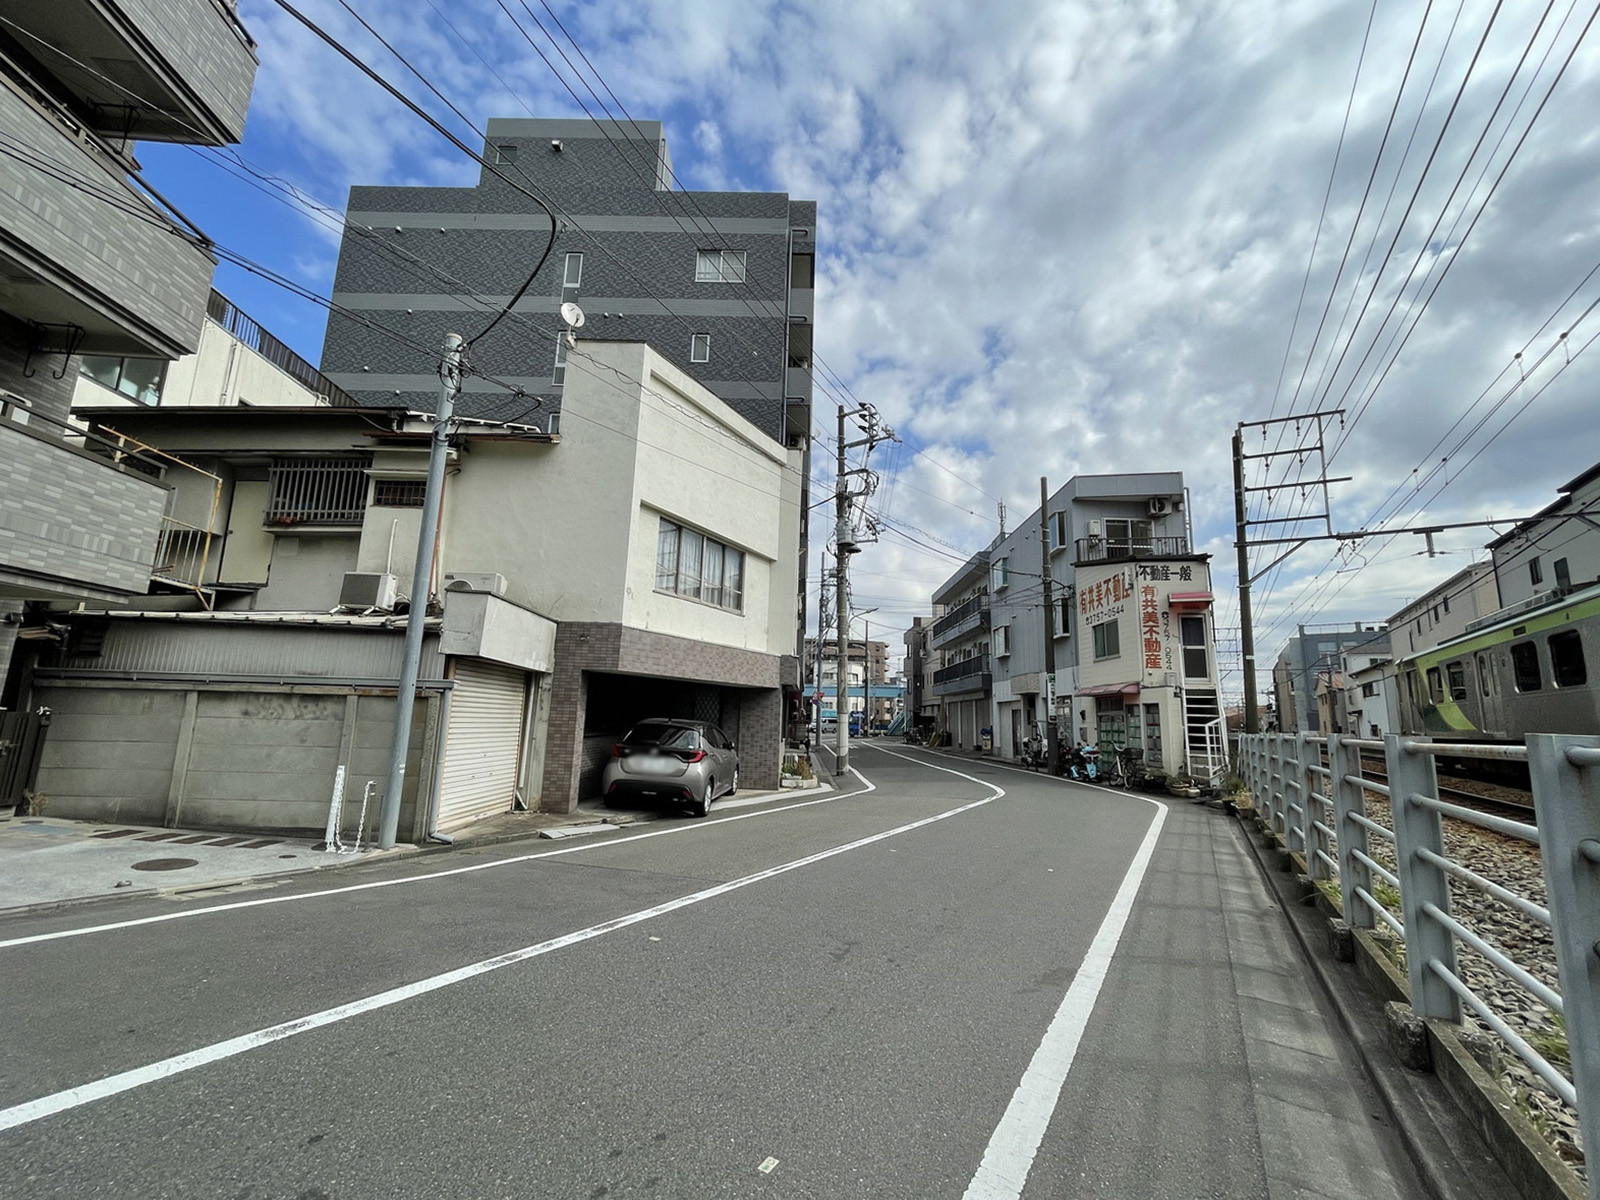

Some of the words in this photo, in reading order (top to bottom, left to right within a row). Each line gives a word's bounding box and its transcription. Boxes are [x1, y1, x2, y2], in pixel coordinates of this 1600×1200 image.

[1138, 565, 1192, 581] 不動産一般
[1141, 585, 1162, 669] 有共美不動産
